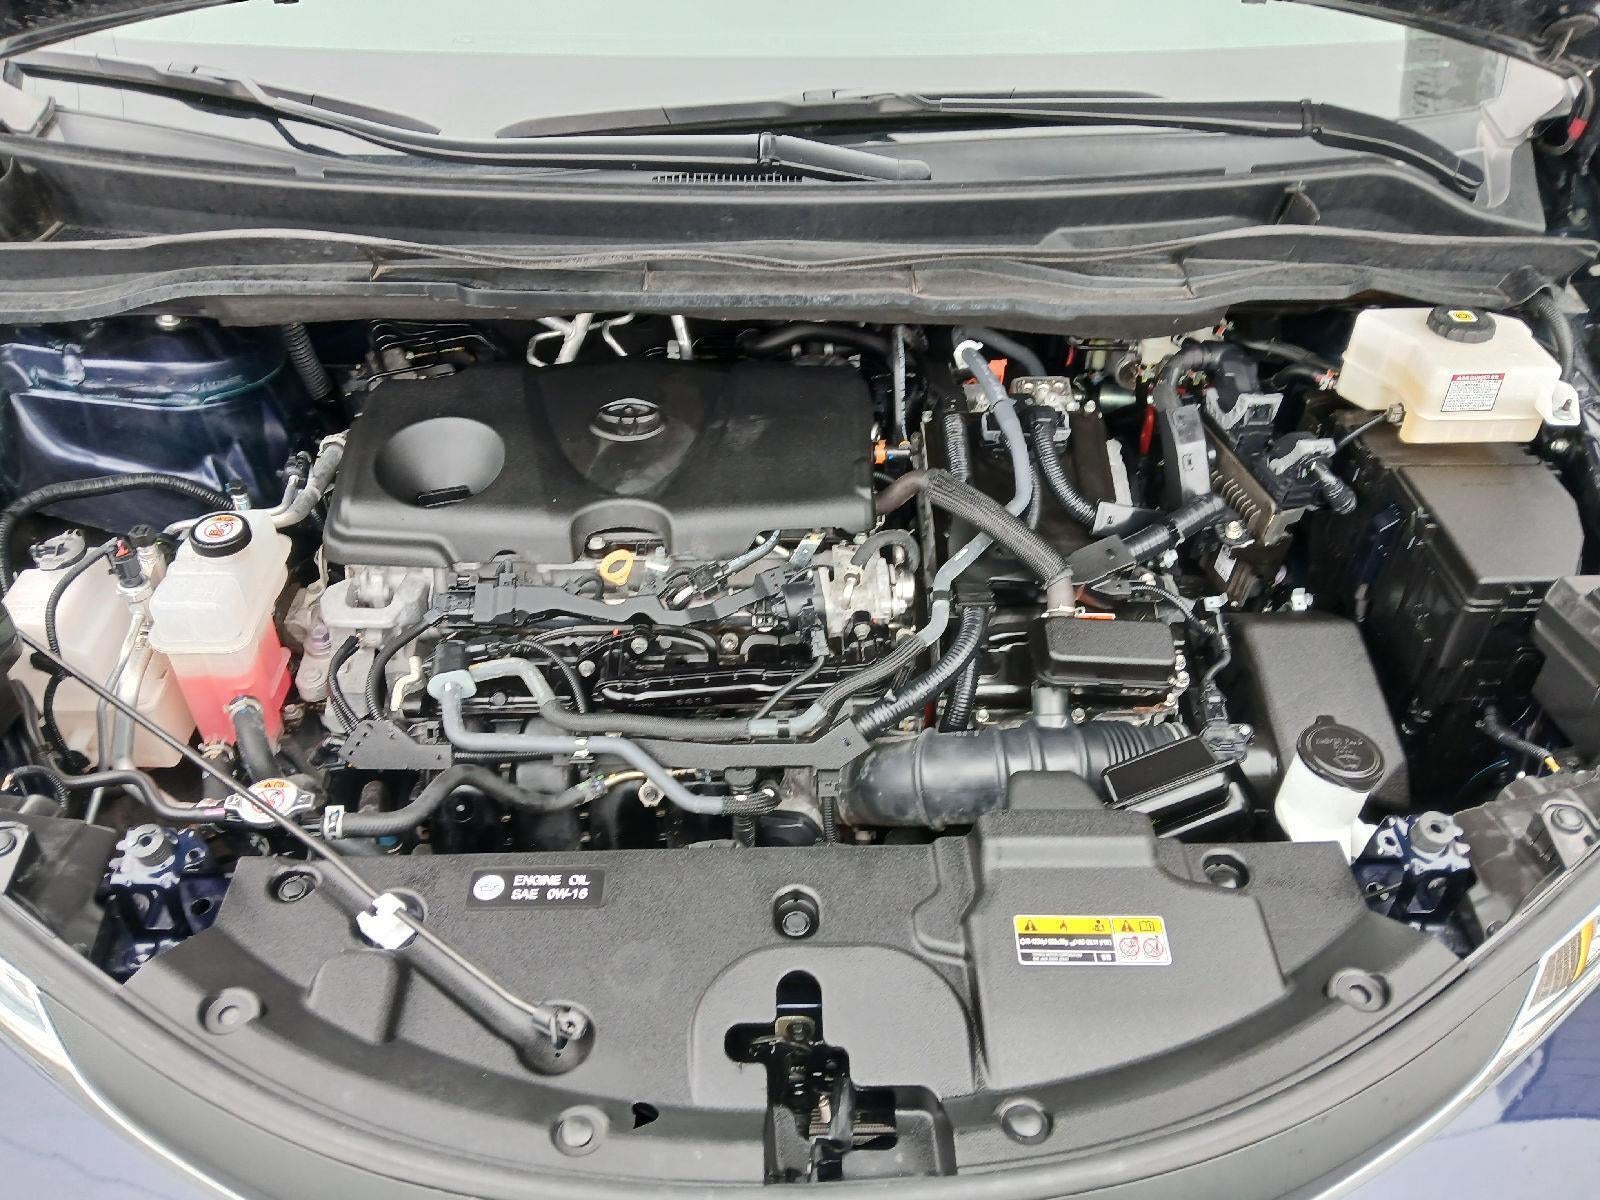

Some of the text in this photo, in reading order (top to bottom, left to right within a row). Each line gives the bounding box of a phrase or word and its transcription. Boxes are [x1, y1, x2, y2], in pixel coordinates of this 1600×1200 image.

[513, 874, 591, 887] ENGINE OIL
[510, 888, 540, 900] SAE
